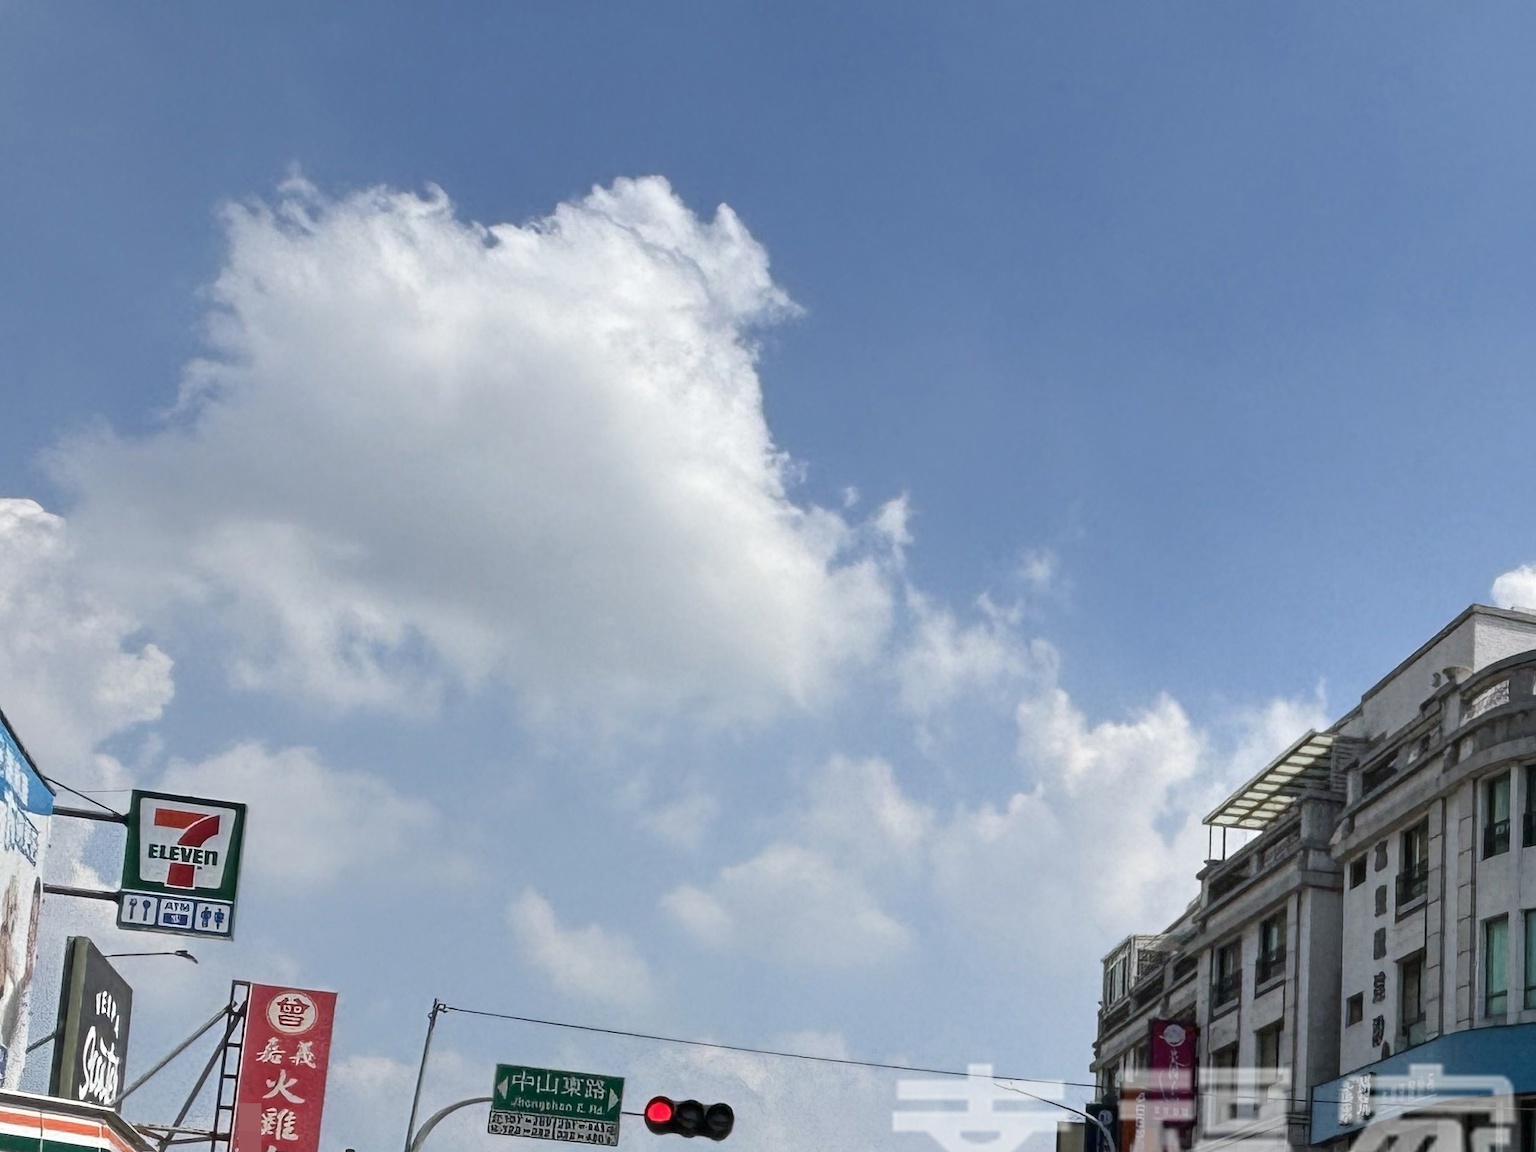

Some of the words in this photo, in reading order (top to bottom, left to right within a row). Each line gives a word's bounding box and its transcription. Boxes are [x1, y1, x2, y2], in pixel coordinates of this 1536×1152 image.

[164, 901, 190, 913] ATM
[511, 1070, 608, 1099] 中山東路
